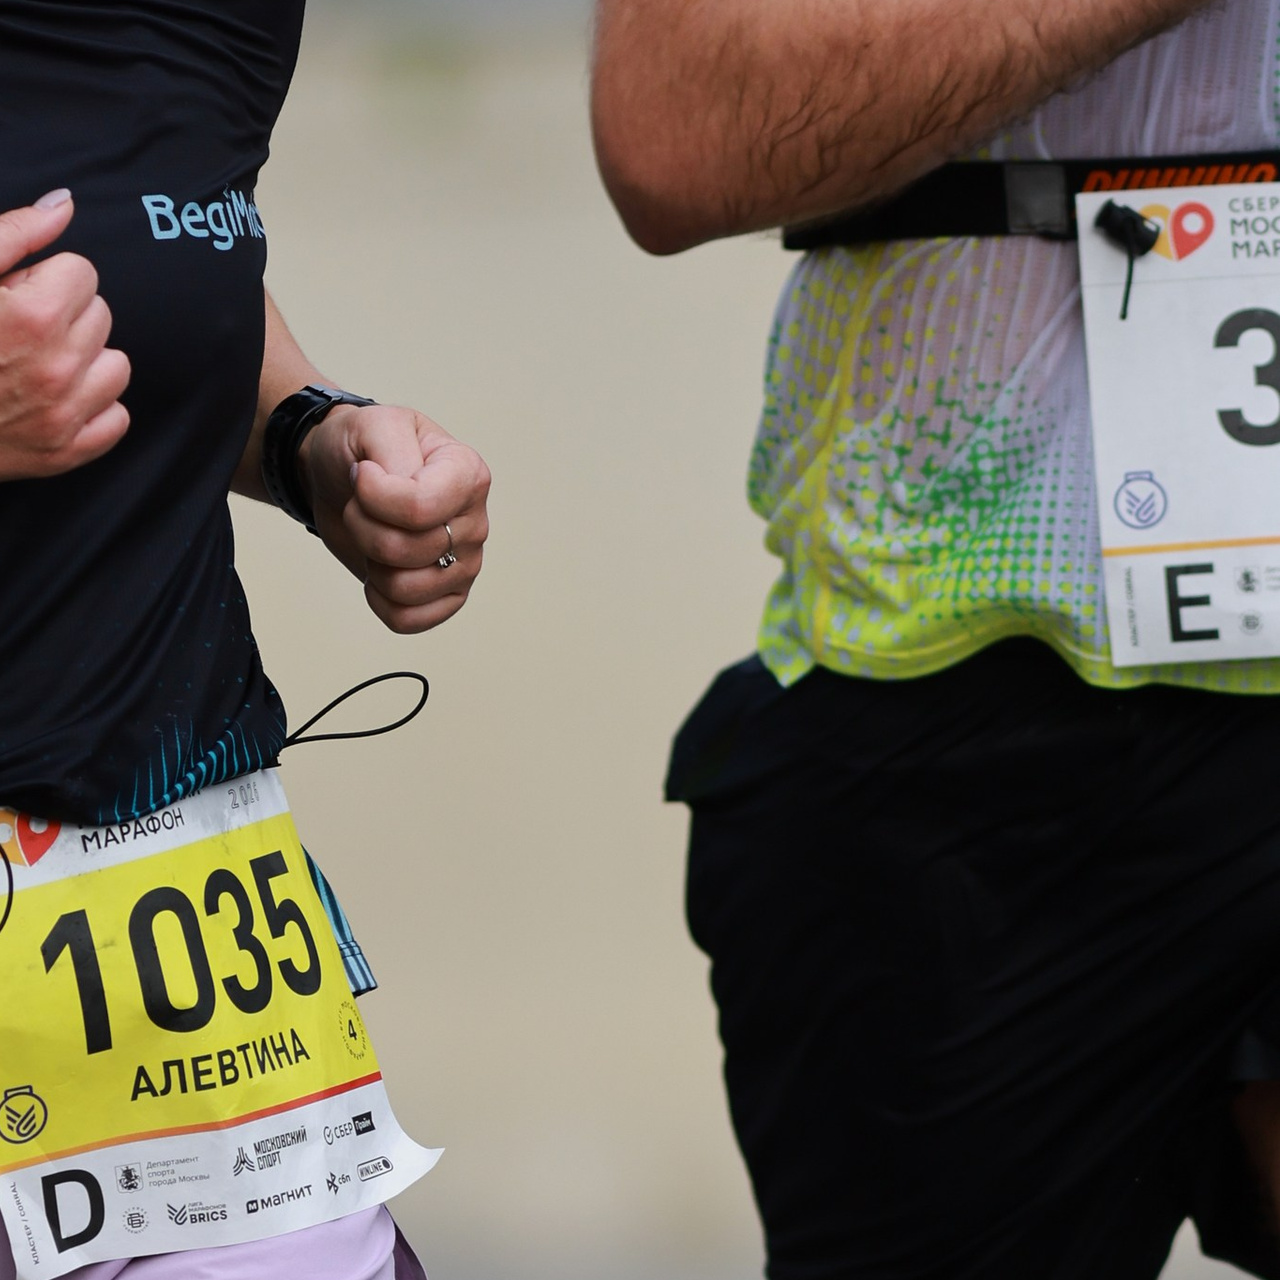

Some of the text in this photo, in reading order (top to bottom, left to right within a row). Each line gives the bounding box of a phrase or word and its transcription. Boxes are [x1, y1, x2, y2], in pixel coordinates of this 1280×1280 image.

[1228, 196, 1280, 213] СБЕР
[1213, 307, 1280, 447] 3
[1164, 562, 1220, 643] E
[80, 807, 185, 853] МАРАФОН
[39, 850, 323, 1055] 1035
[348, 1019, 358, 1041] 4
[130, 1028, 311, 1102] АЛЕВТИНА
[253, 1125, 307, 1157] МОСКОВСКИЙ
[334, 1122, 353, 1139] СБЕР
[146, 1156, 199, 1170] Департамент
[147, 1168, 175, 1178] спорта
[256, 1151, 282, 1171] СПОРТ
[359, 1161, 384, 1180] WINLINE
[148, 1174, 210, 1188] города Москвы
[9, 1181, 26, 1217] CORRAL
[41, 1169, 106, 1255] D
[190, 1209, 228, 1224] BRICS
[22, 1224, 40, 1265] КЛАСТЕР
